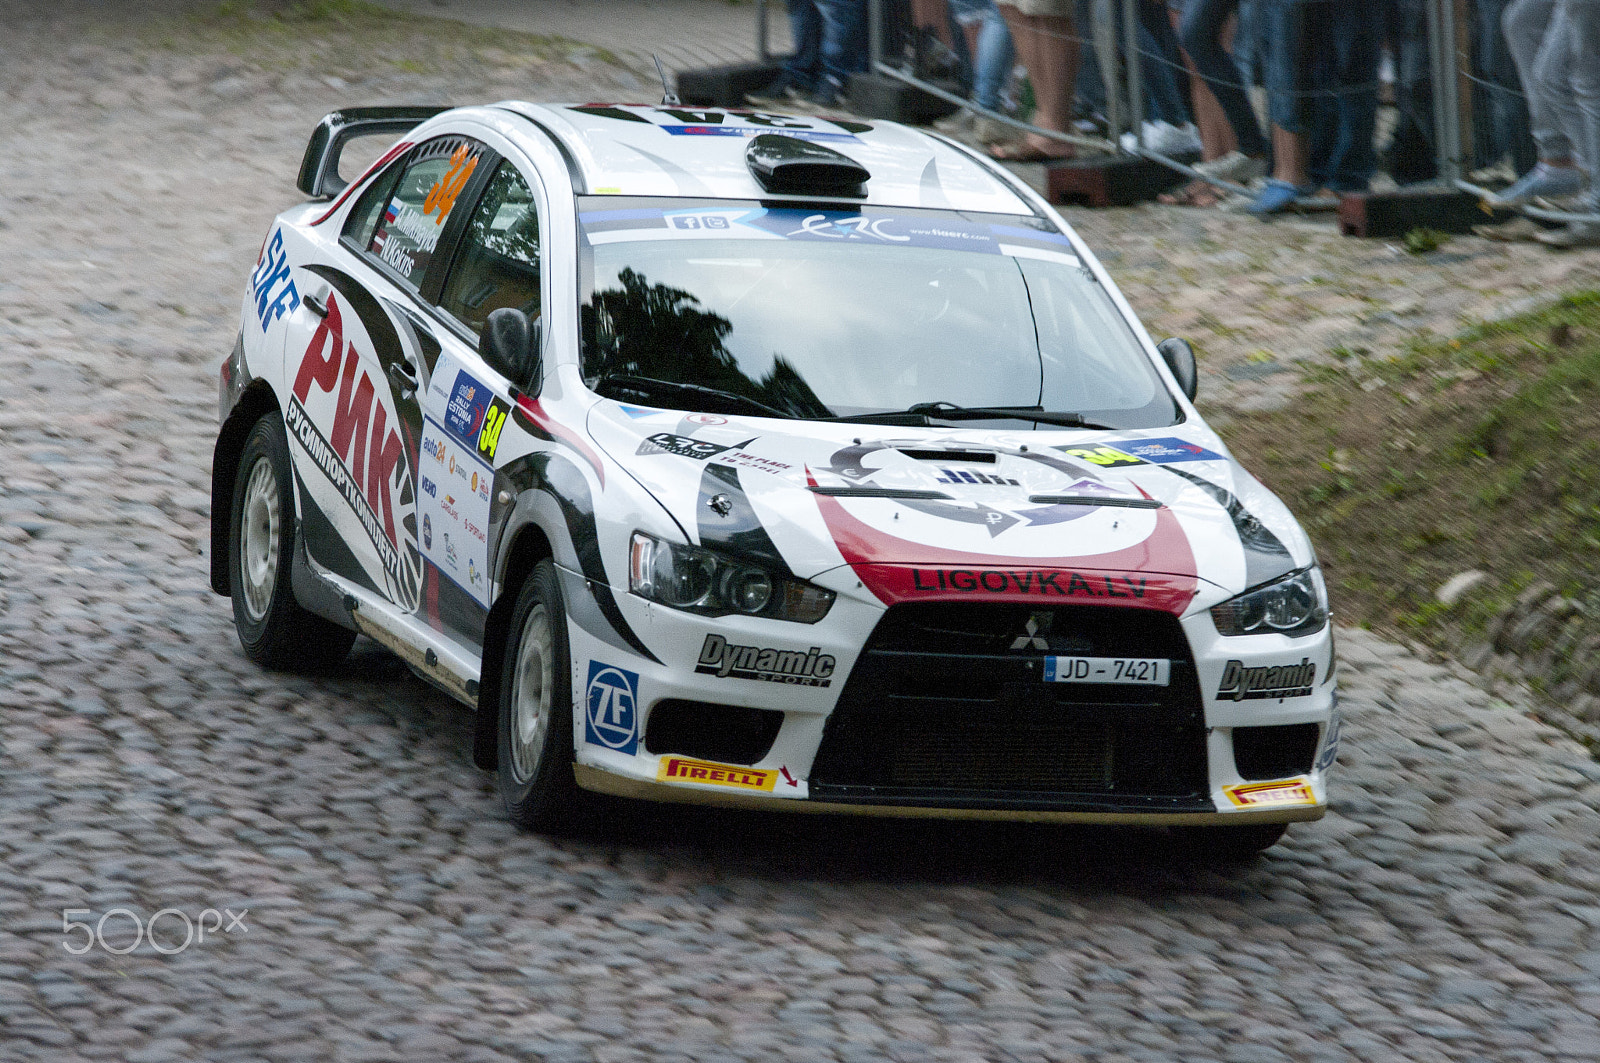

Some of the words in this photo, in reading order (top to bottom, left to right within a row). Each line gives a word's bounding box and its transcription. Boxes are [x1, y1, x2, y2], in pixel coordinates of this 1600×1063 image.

[423, 142, 479, 226] 34
[253, 226, 300, 333] SKF
[448, 401, 472, 425] ESTONIA
[455, 396, 471, 409] RALLY
[480, 405, 507, 458] 34
[422, 436, 446, 465] auto24
[1065, 447, 1140, 465] 34
[286, 400, 399, 575] РУСИМПОРТКОМПЛЕКТ
[421, 474, 437, 499] VEHO
[912, 568, 1147, 599] LIGOVKA.LV
[697, 632, 837, 679] Dynamic
[757, 673, 831, 688] SPORT
[1218, 658, 1317, 702] Dynamic
[592, 680, 633, 735] ZF
[666, 758, 768, 787] PIRELLI
[1231, 782, 1310, 805] PIRELLI
